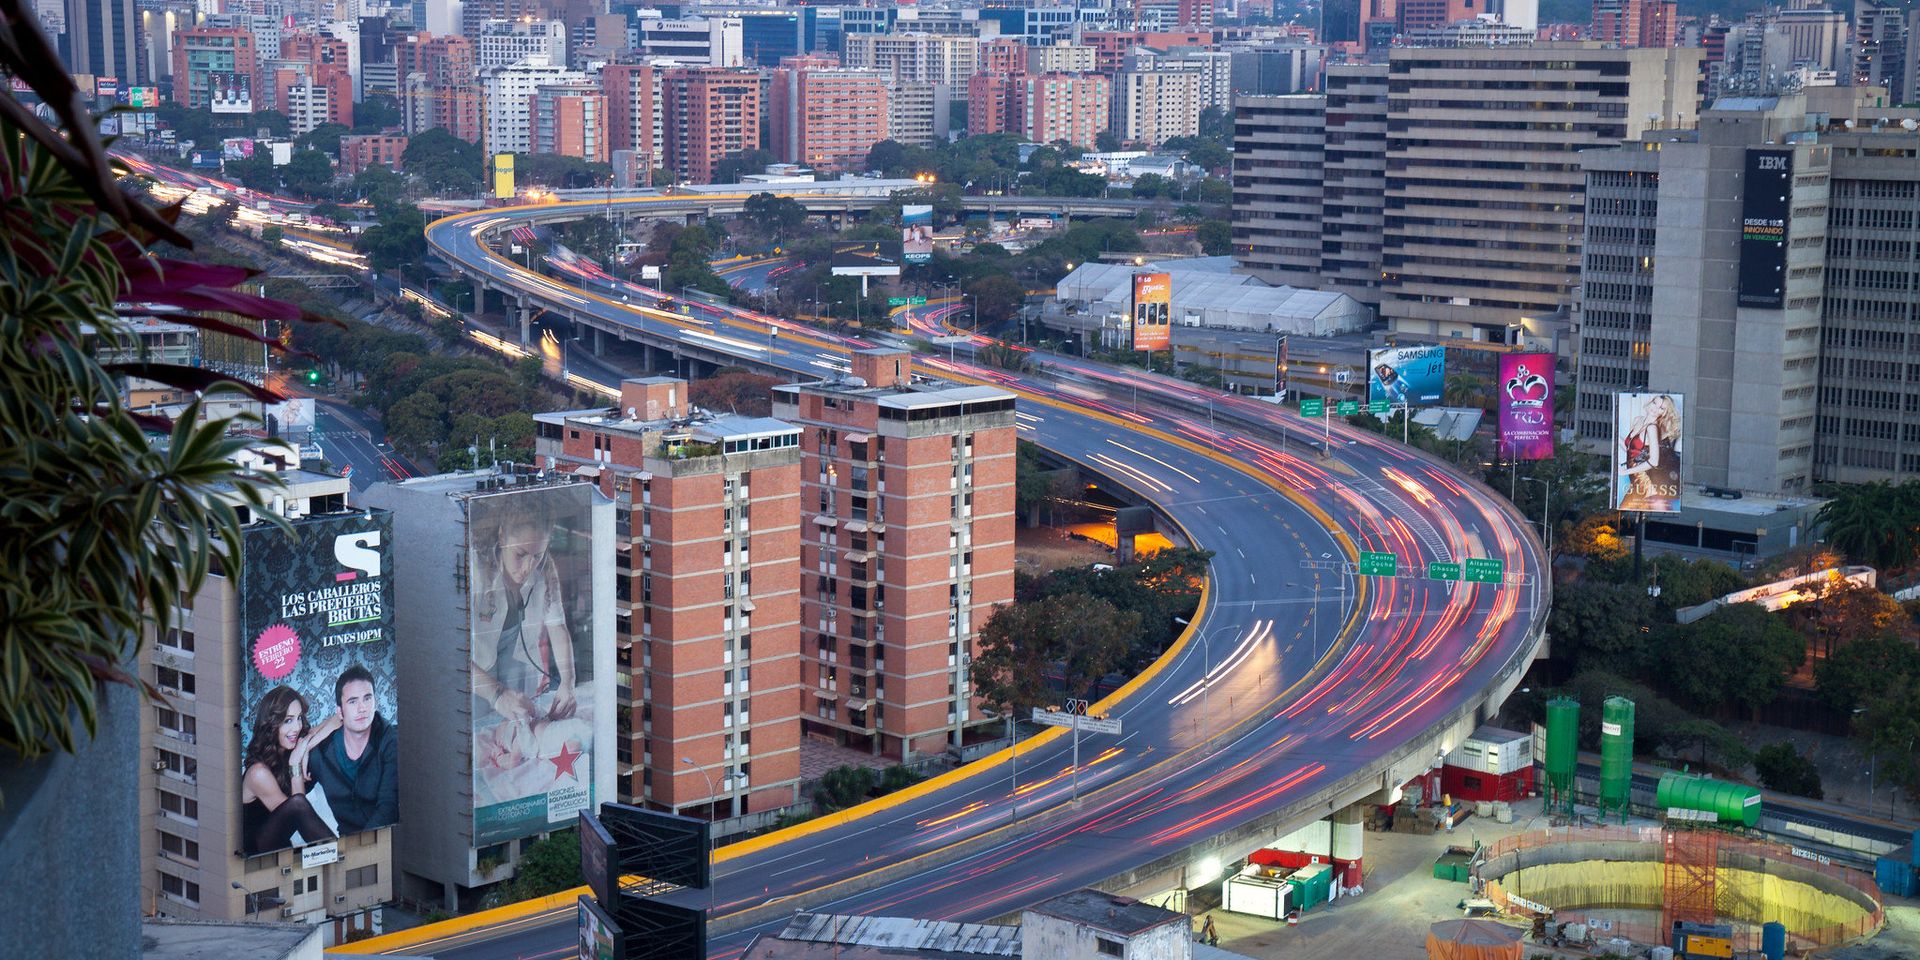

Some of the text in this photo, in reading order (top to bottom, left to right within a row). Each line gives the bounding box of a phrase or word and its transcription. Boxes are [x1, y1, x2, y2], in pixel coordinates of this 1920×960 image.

[1758, 156, 1787, 170] IBM
[1744, 226, 1784, 234] INNOVANDO
[1398, 350, 1444, 360] SAMSUNG
[1623, 484, 1677, 496] GUESS
[282, 581, 381, 607] LOS CABALLEROS
[282, 592, 381, 618] LAS PREFIEREN
[328, 604, 382, 624] BRUTAS
[258, 637, 294, 659] ESTRENO
[260, 646, 294, 665] FEBRERO
[274, 657, 286, 669] 22
[549, 786, 575, 797] MISIONES
[549, 790, 587, 803] BOLIVARIANAS
[498, 798, 546, 816] EXTRAORDINARIO
